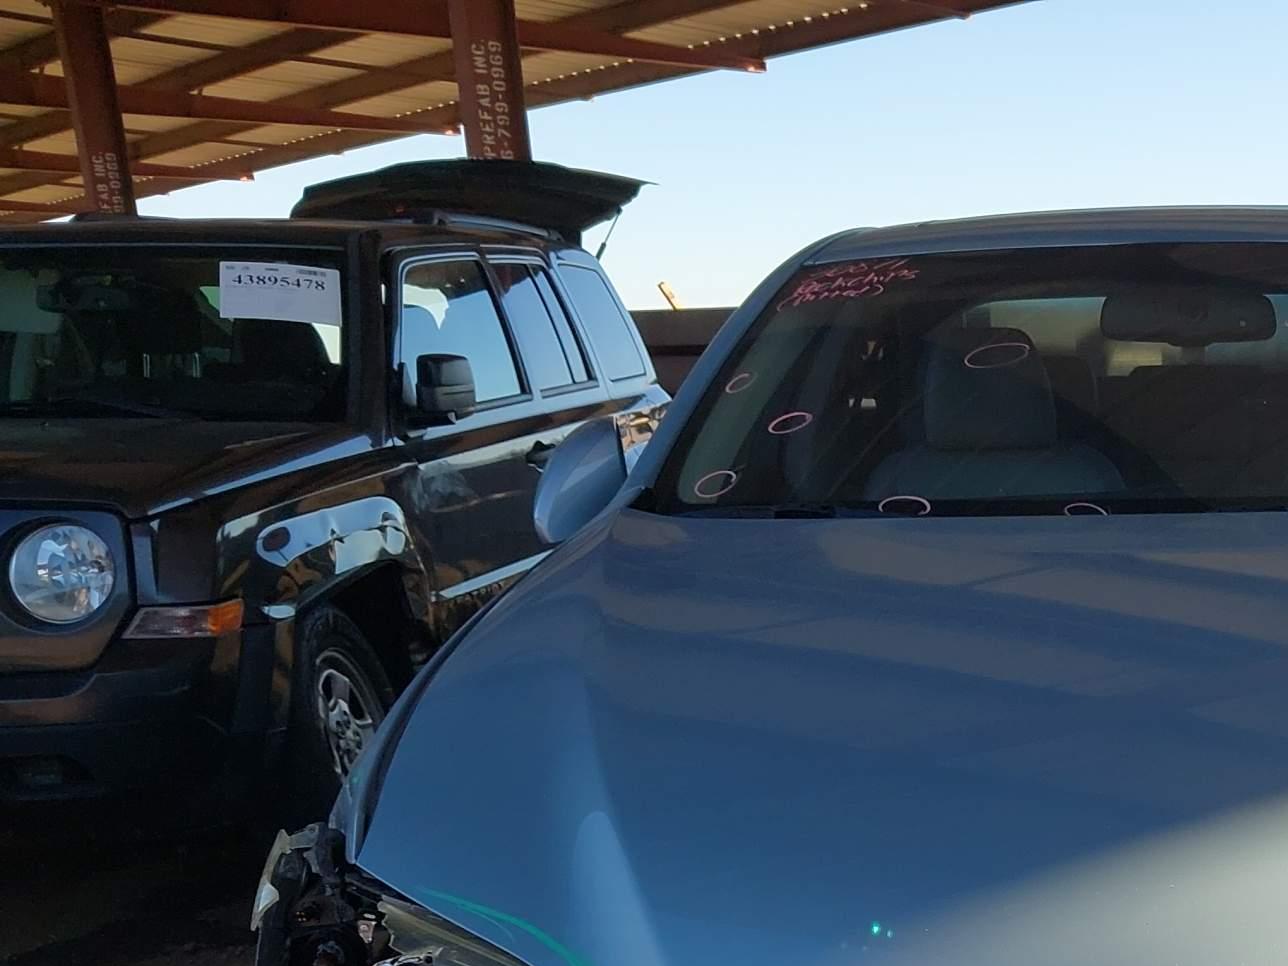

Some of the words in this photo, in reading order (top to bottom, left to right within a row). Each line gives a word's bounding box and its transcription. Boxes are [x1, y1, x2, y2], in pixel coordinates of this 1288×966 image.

[471, 39, 488, 74] INC.
[476, 83, 497, 159] PREFAB
[232, 274, 325, 291] 43895478
